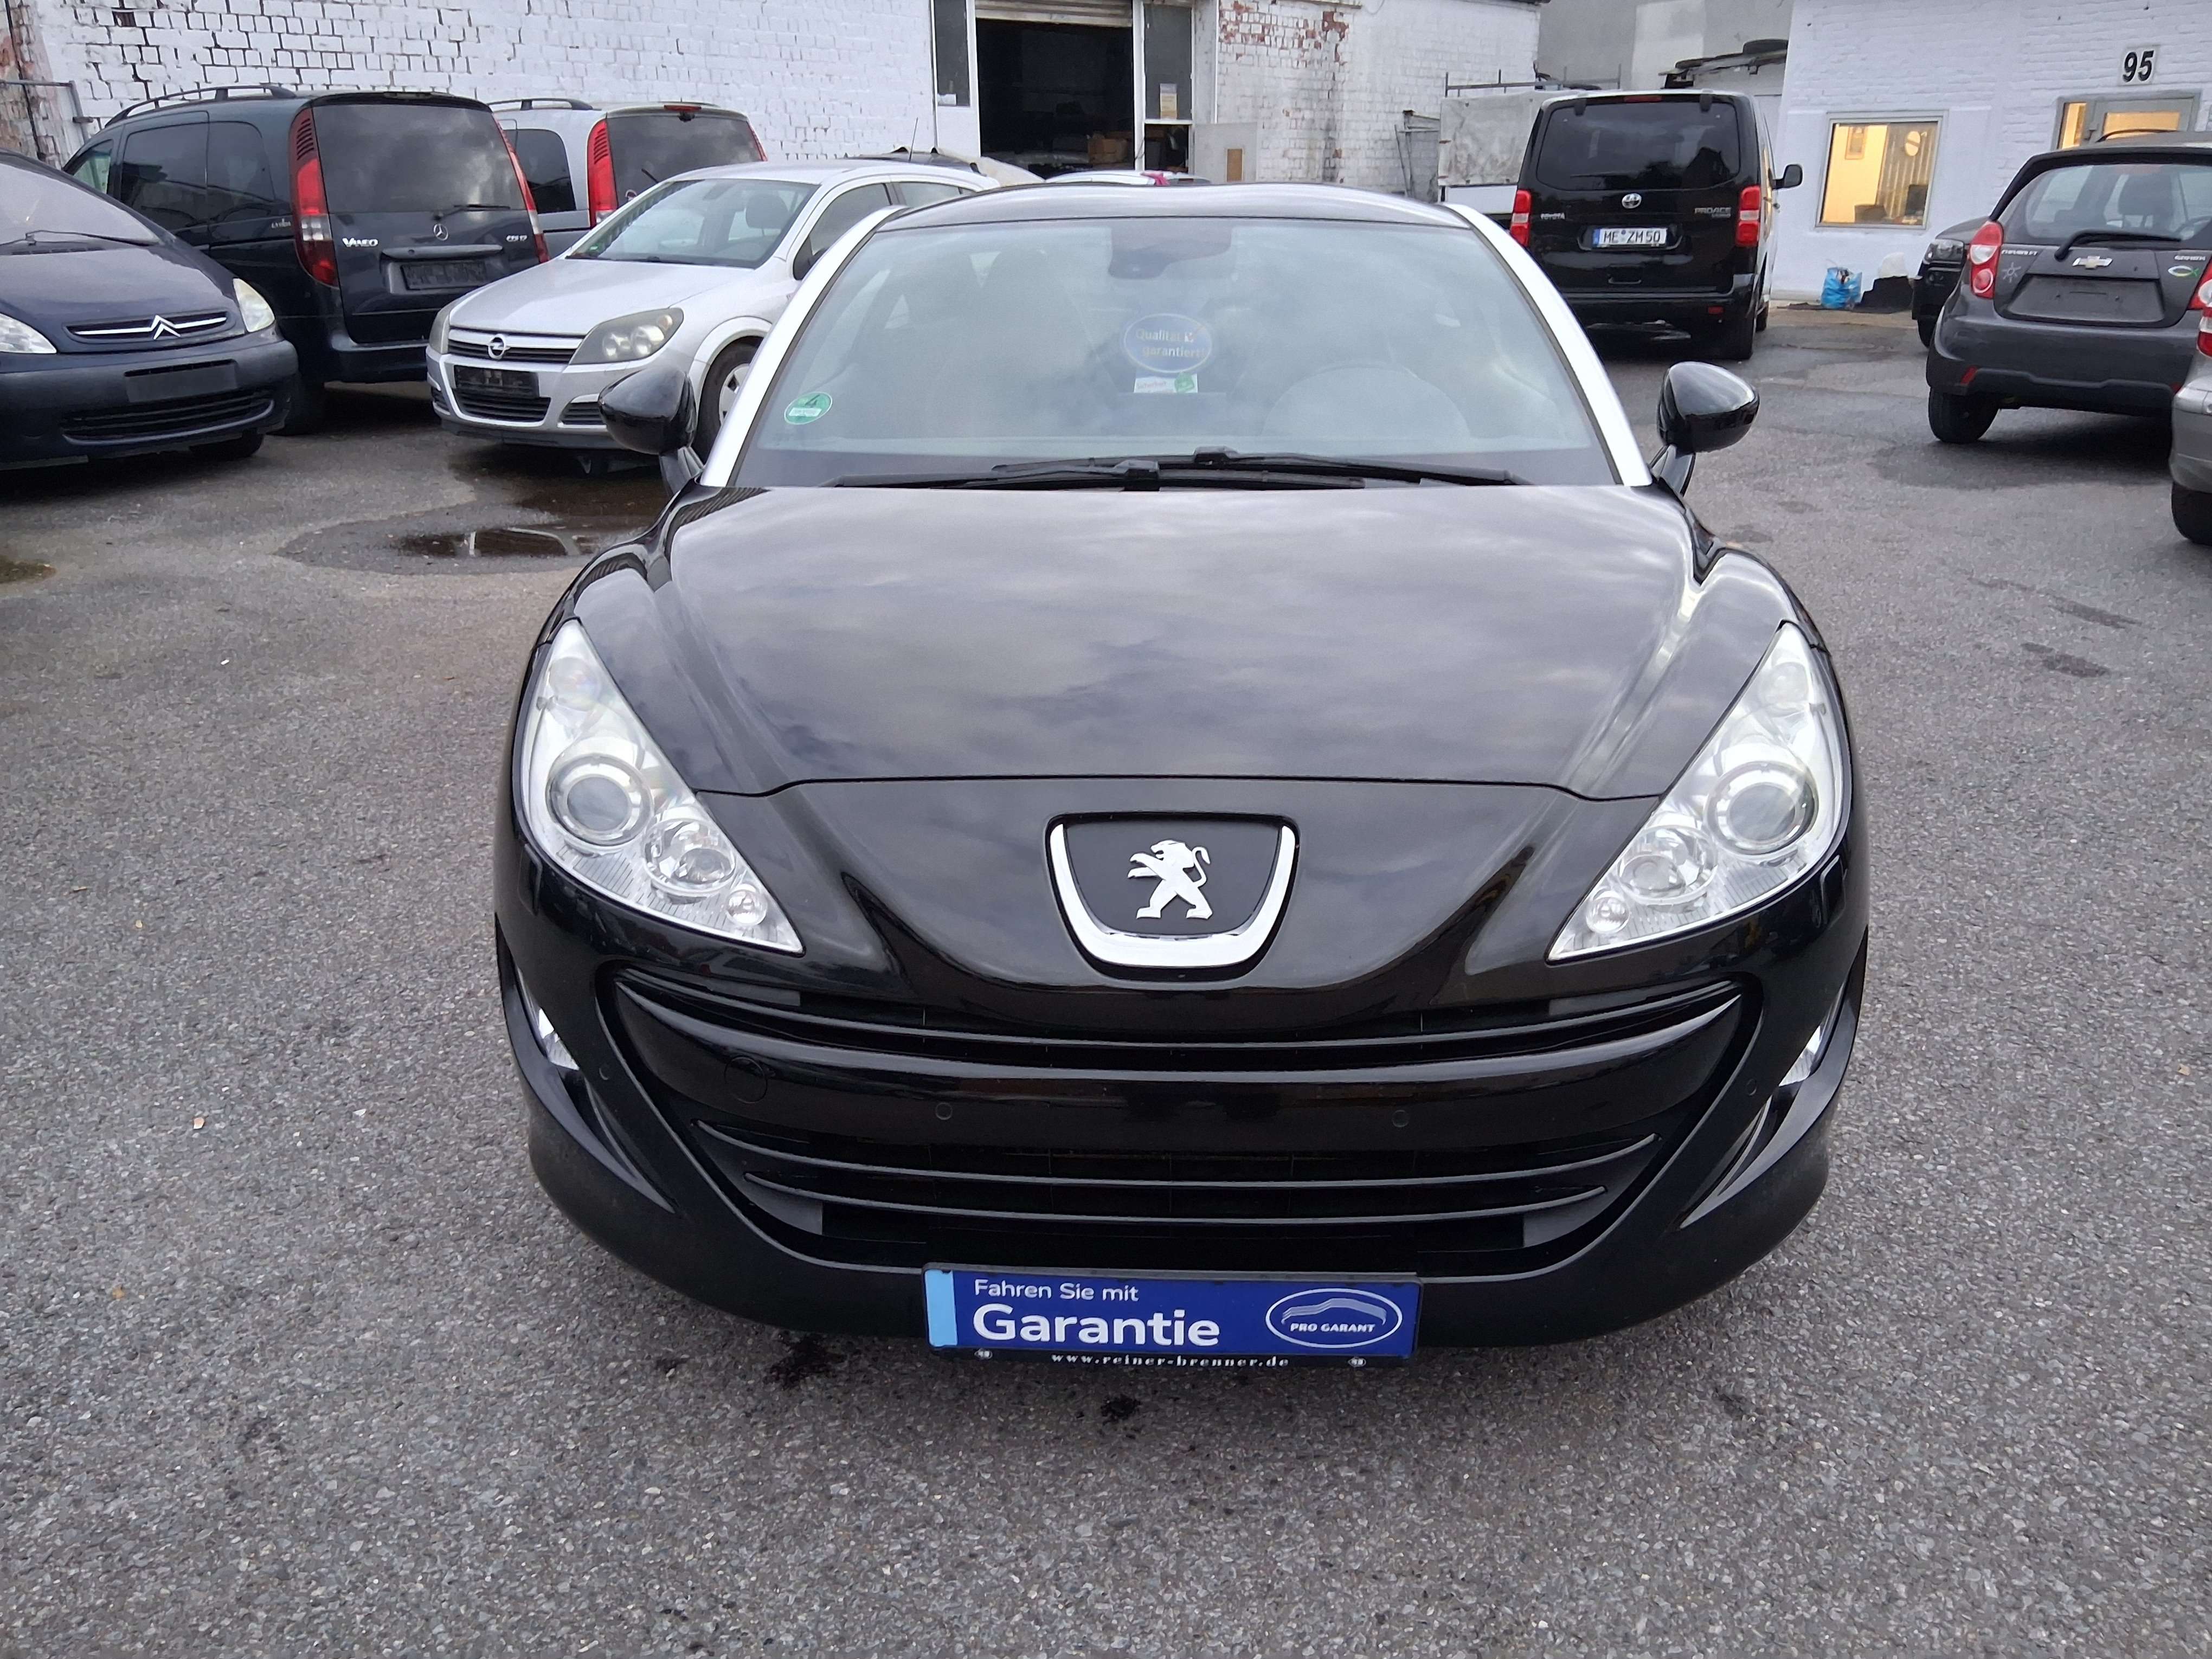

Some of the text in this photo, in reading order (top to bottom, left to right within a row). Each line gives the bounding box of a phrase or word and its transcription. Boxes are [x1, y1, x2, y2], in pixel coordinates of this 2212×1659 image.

[2123, 50, 2155, 82] 95
[1603, 230, 1661, 243] ME ZM 50
[974, 1279, 1139, 1302] Fahren Sie mit
[973, 1303, 1220, 1346] Garantie
[1290, 1323, 1375, 1333] PRO GARANT
[1051, 1354, 1289, 1367] www.reiner-brenner.de
